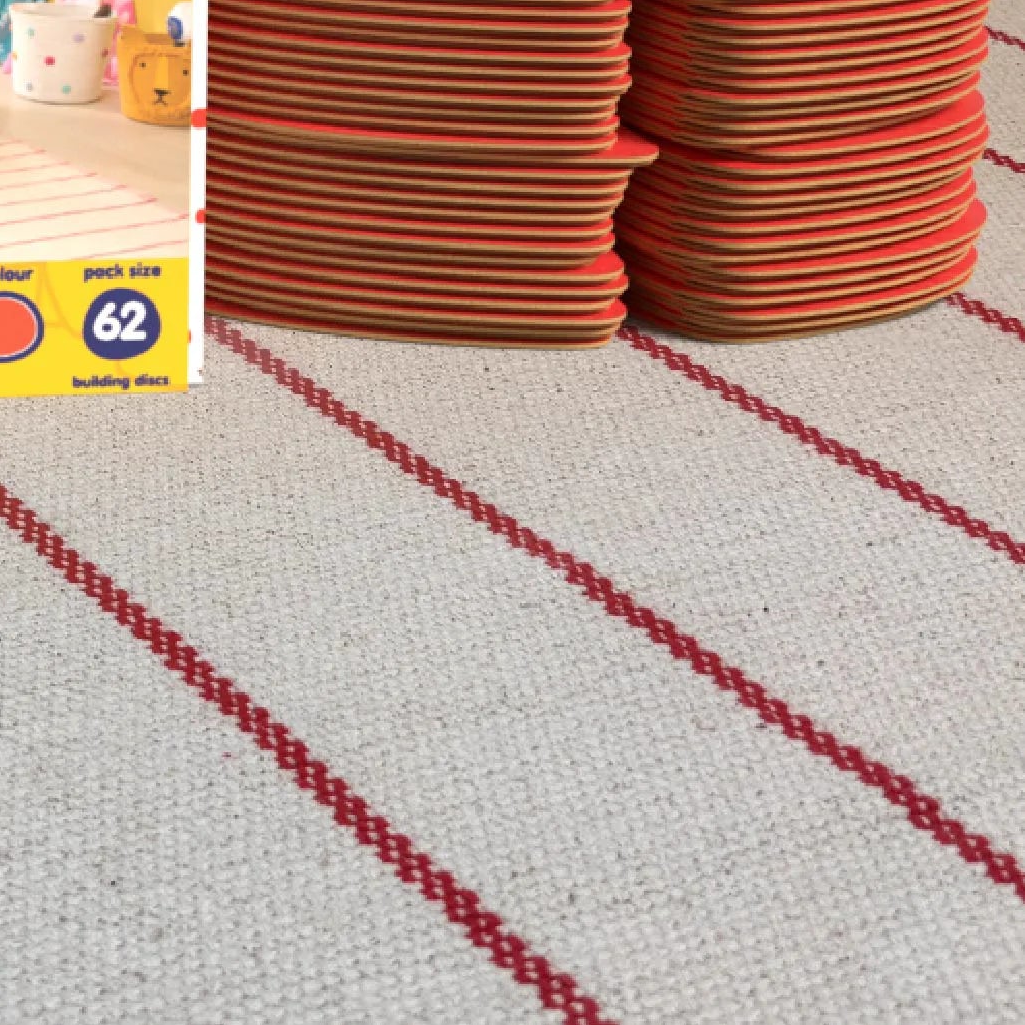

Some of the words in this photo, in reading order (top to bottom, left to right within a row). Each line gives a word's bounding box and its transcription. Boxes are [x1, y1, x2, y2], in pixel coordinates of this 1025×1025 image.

[83, 264, 124, 283] pack
[128, 263, 161, 278] size
[92, 301, 147, 342] 62
[72, 375, 130, 390] building
[134, 373, 170, 388] discs
